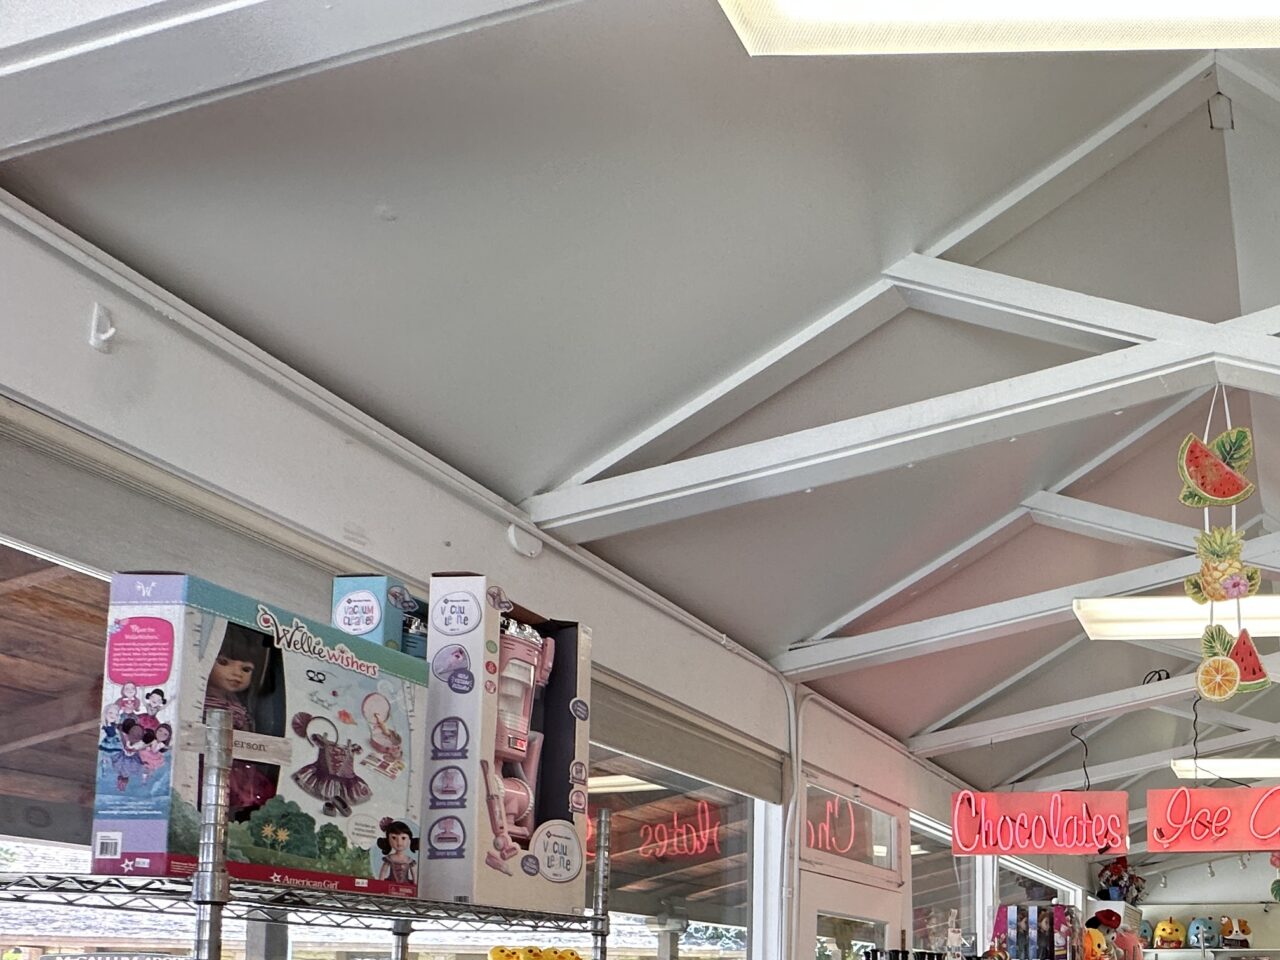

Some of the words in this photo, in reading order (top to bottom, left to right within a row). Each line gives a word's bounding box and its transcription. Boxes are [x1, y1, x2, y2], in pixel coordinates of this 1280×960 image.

[233, 740, 266, 752] erson
[954, 789, 1122, 852] Chocolates
[1153, 786, 1232, 848] Ice
